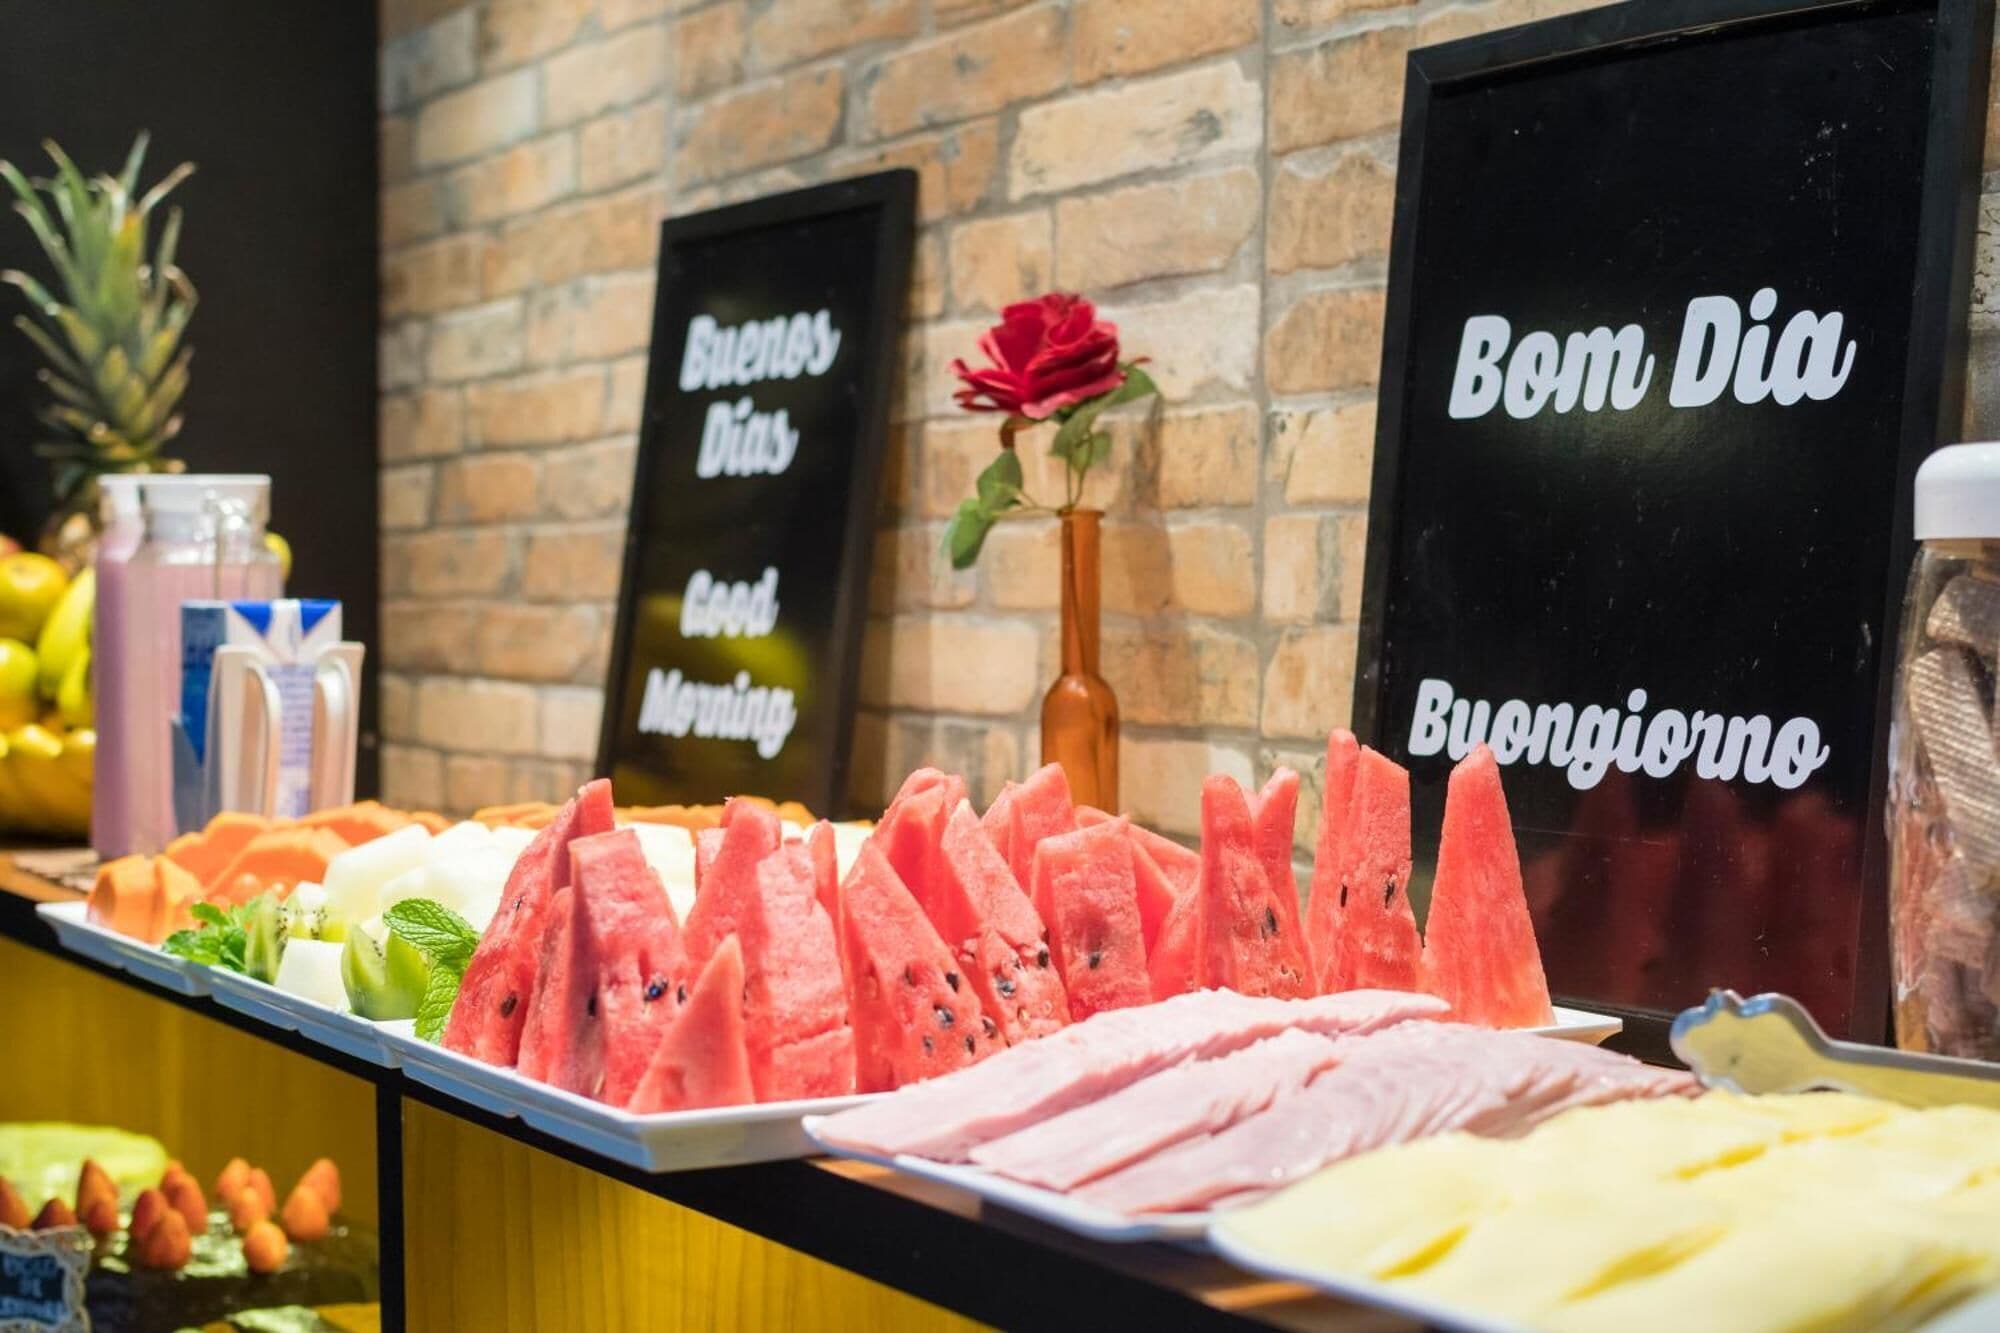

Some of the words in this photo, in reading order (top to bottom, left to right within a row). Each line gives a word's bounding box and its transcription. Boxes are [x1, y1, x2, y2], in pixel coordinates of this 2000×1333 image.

[679, 309, 841, 391] Buenos
[1448, 314, 1656, 420] Bom
[1668, 287, 1857, 408] Dia
[679, 567, 780, 639] Good
[638, 668, 797, 759] Morning
[1407, 678, 1831, 790] Buongiorno
